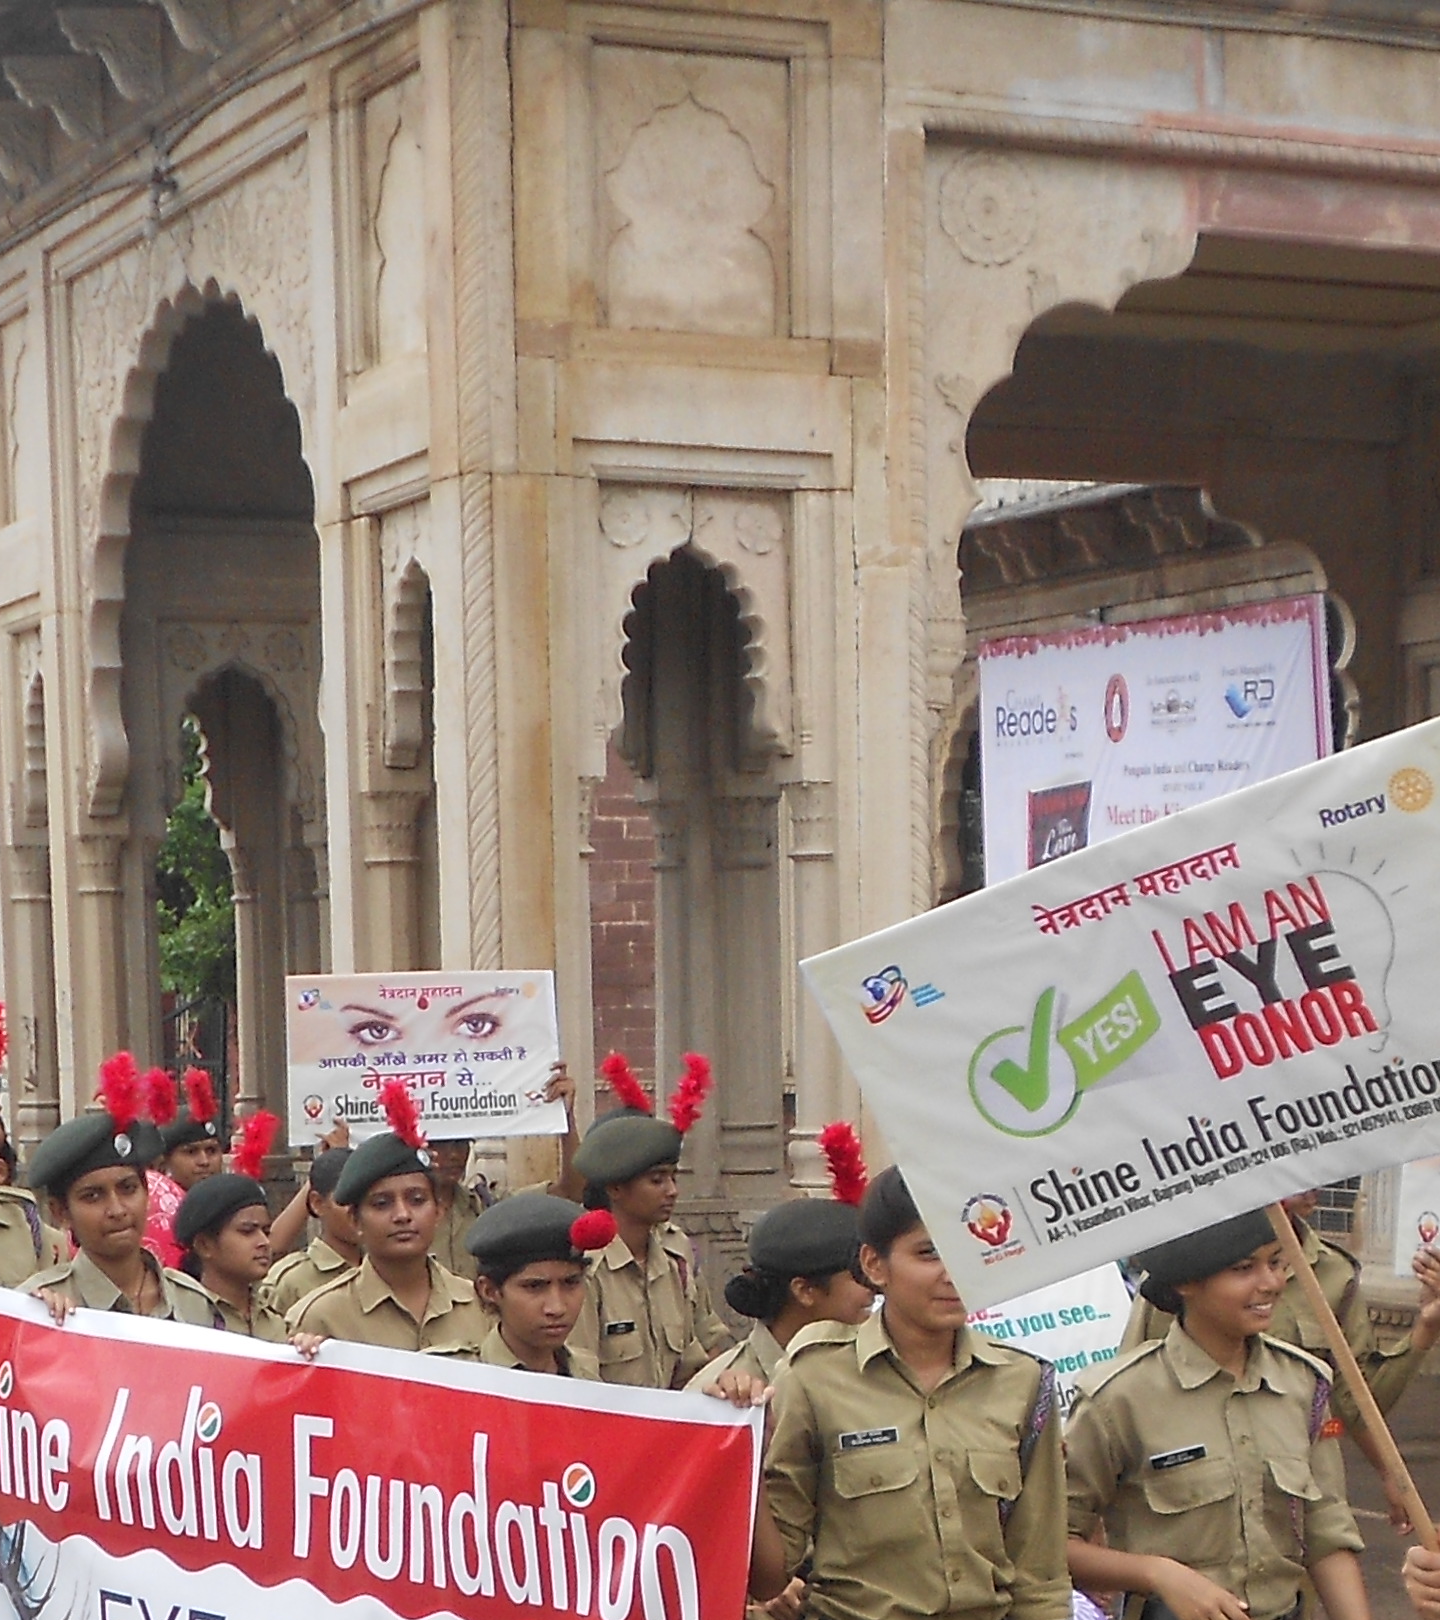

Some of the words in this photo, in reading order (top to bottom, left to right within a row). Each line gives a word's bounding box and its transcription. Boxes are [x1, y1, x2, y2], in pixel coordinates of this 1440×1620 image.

[1107, 804, 1138, 826] Meet
[1140, 804, 1160, 826] the
[1318, 791, 1386, 829] Rotary
[1032, 883, 1132, 936] नेत्रदान
[1133, 842, 1241, 897] महादान
[1152, 930, 1178, 974] I
[1182, 902, 1259, 968] AM
[1260, 875, 1331, 942] AN
[378, 984, 417, 999] नेत्रदान
[1168, 920, 1357, 1029] EYE
[318, 1051, 367, 1070] आपकी
[413, 1052, 448, 1066] अमर
[452, 1047, 468, 1064] हो
[473, 1047, 513, 1063] सकती
[517, 1044, 529, 1061] है
[1073, 994, 1144, 1065] YES!
[1198, 979, 1380, 1079] DONOR
[335, 1095, 379, 1117] Shine
[431, 1089, 517, 1112] Foundation
[1029, 1160, 1141, 1224] Shine
[1141, 1116, 1249, 1181] India
[1016, 1316, 1056, 1336] you
[92, 1384, 263, 1551] India
